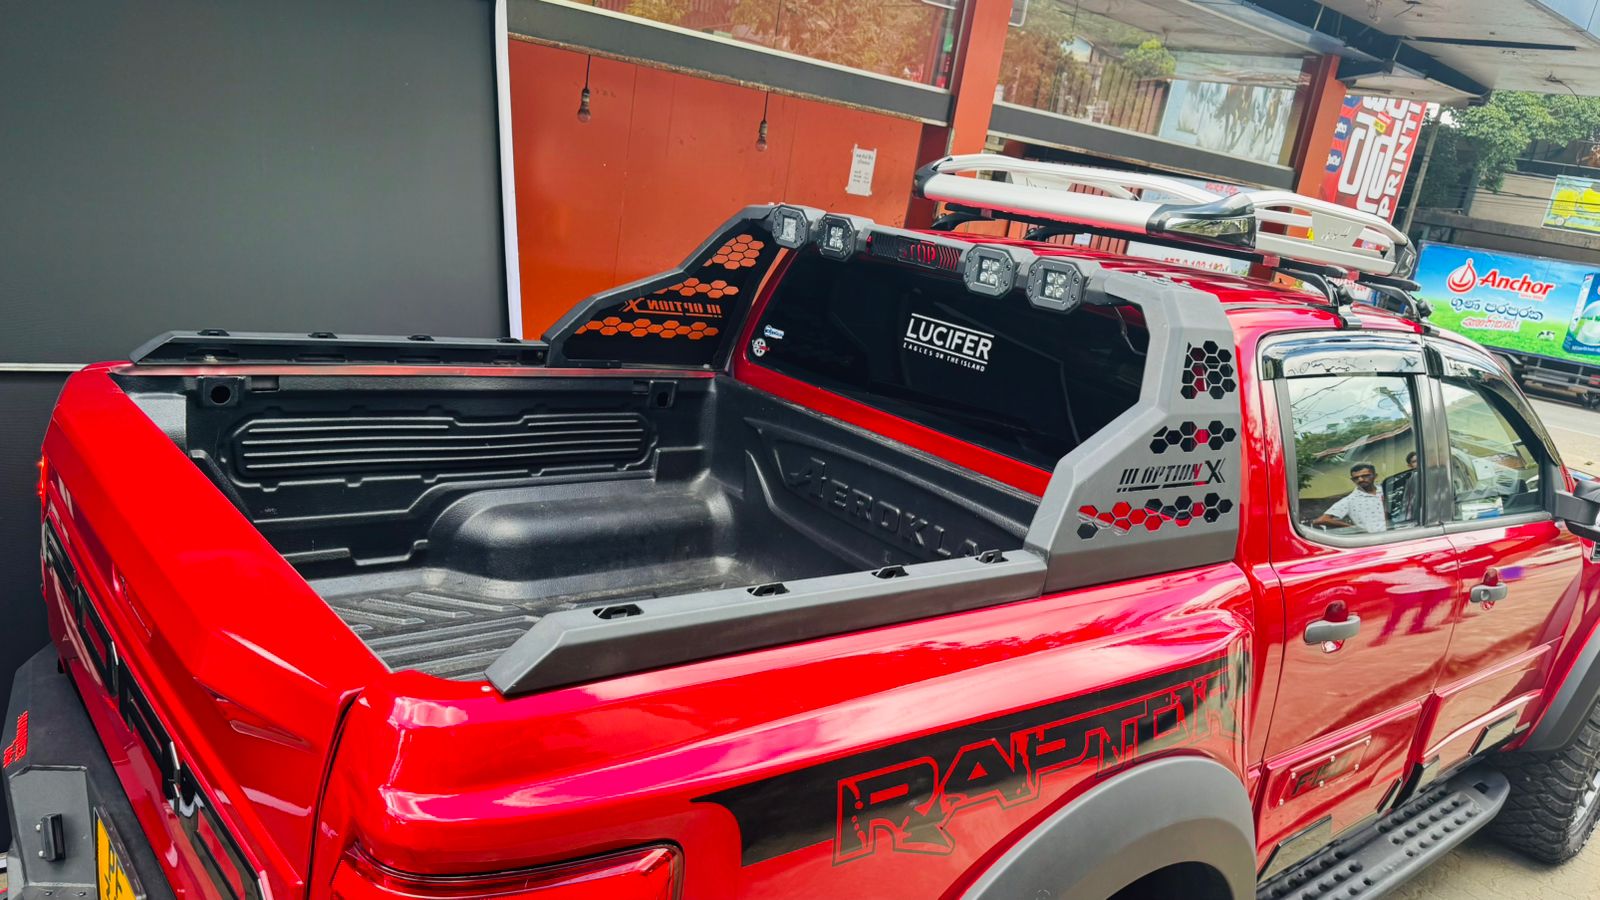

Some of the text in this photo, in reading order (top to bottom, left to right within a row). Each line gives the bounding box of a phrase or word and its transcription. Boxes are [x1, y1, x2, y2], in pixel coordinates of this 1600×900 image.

[1479, 269, 1554, 296] Anchor
[906, 318, 993, 361] LUCIFER
[902, 342, 986, 373] EAGLES ON THE ISLAND
[1141, 463, 1203, 484] OPTION
[832, 664, 1245, 867] RAPTOR
